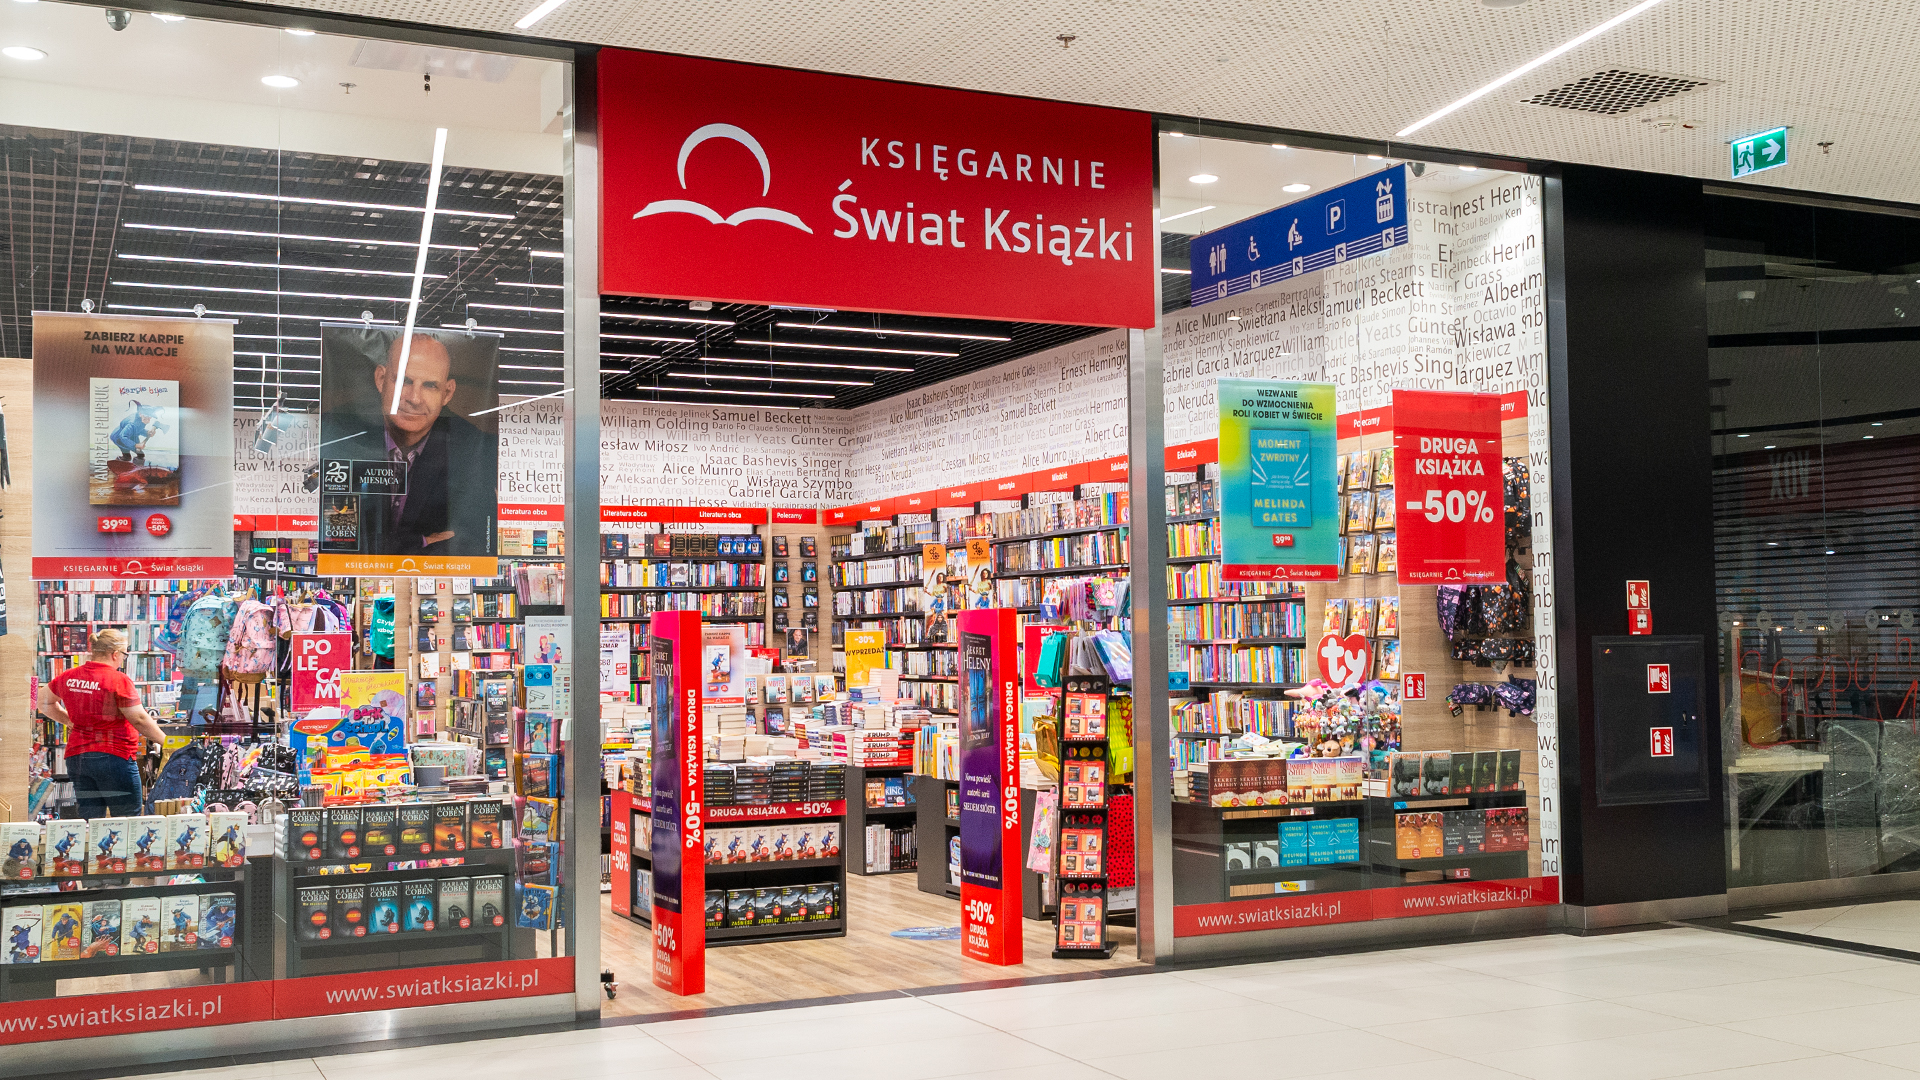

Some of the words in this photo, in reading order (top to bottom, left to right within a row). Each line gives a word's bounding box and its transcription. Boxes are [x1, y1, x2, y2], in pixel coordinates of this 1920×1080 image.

[860, 137, 1106, 189] KSIĘGARNIE
[832, 178, 966, 249] Świat
[985, 207, 1133, 266] Książki
[1330, 206, 1341, 230] P
[1371, 281, 1424, 307] Beckett
[1174, 319, 1199, 337] Alice
[84, 331, 135, 343] ZABIERZ
[139, 334, 184, 345] KARPIE
[1227, 330, 1280, 352] Sienkiewicz
[91, 344, 111, 355] NA
[114, 345, 178, 357] WAKACJE
[1233, 345, 1281, 368] Márquez
[1061, 363, 1087, 381] Ernest
[1257, 389, 1298, 399] WEZWANIE
[94, 384, 109, 429] PILIPIUK
[1000, 404, 1027, 423] Samuel
[1029, 398, 1057, 416] Beckett
[1242, 399, 1254, 408] DO
[1256, 399, 1314, 410] WZMOCNIENIA
[679, 409, 711, 419] Jelinek
[712, 408, 760, 423] Samuel
[764, 411, 812, 425] Beckett
[1233, 409, 1251, 418] ROLI
[1253, 410, 1280, 419] KOBIET
[1282, 411, 1290, 419] W
[1292, 409, 1323, 421] ŚWIECIE
[601, 415, 651, 428] William
[656, 417, 709, 434] Golding
[800, 424, 820, 435] John
[666, 429, 711, 442] William
[755, 433, 787, 445] Yeats
[791, 434, 834, 446] Günter
[1084, 428, 1111, 444] Albert
[1258, 439, 1301, 450] MOMENT
[645, 439, 688, 453] Miłosz
[1176, 448, 1197, 460] Edukacja
[1420, 437, 1479, 455] DRUGA
[94, 433, 109, 481] ANDRZEJ
[705, 453, 738, 465] Isaac
[743, 454, 797, 467] Bashevis
[802, 456, 842, 470] Singer
[1260, 452, 1300, 463] ZWROTNY
[364, 468, 394, 477] AUTOR
[662, 462, 695, 475] Alice
[700, 463, 743, 477] Munro
[1415, 455, 1485, 480] KSIĄŻKA
[359, 476, 399, 486] MIESIĄCA
[508, 481, 562, 494] Beckett
[615, 473, 678, 485] Aleksander
[746, 476, 798, 488] Wisława
[729, 485, 775, 498] Gabriel
[1254, 498, 1306, 509] MELINDA
[1406, 489, 1494, 523] -50%
[777, 512, 802, 520] Polecamy
[1262, 513, 1298, 522] GATES
[148, 524, 168, 532] -50%
[63, 564, 118, 573] KSIĘGARNIE
[151, 562, 174, 572] Świat
[176, 563, 204, 573] Książki
[345, 562, 394, 570] KSIĘGARNIE
[423, 561, 445, 570] Świat
[446, 563, 471, 571] Książki
[1409, 571, 1443, 579] KSIĘGARNIE
[302, 639, 331, 655] PO
[854, 636, 875, 644] -30%
[297, 655, 318, 671] LE
[962, 651, 991, 671] HELENY
[1321, 637, 1367, 684] ty
[66, 678, 101, 691] CZYTAM.
[1005, 681, 1014, 722] DRUGA
[687, 689, 697, 732] DRUGA
[1004, 724, 1015, 772] KSIĄŻKA
[686, 735, 697, 787] KSIĄŻKA
[709, 808, 744, 818] DRUGA
[746, 805, 787, 817] KSIĄŻKA
[795, 802, 832, 815] -50%
[1004, 775, 1018, 829] -50%
[685, 790, 701, 848] -50%
[612, 850, 629, 873] -50%
[370, 890, 398, 898] COBEN
[1403, 886, 1533, 910] www.swiatksiazki.pl
[965, 899, 995, 925] -50%
[1198, 901, 1342, 928] www.swiatksiazki.pl
[654, 923, 676, 951] -50%
[969, 923, 988, 937] DRUGA
[968, 934, 989, 949] KSIĄŻKA
[326, 968, 539, 1004] www.swiatksiazki.pl
